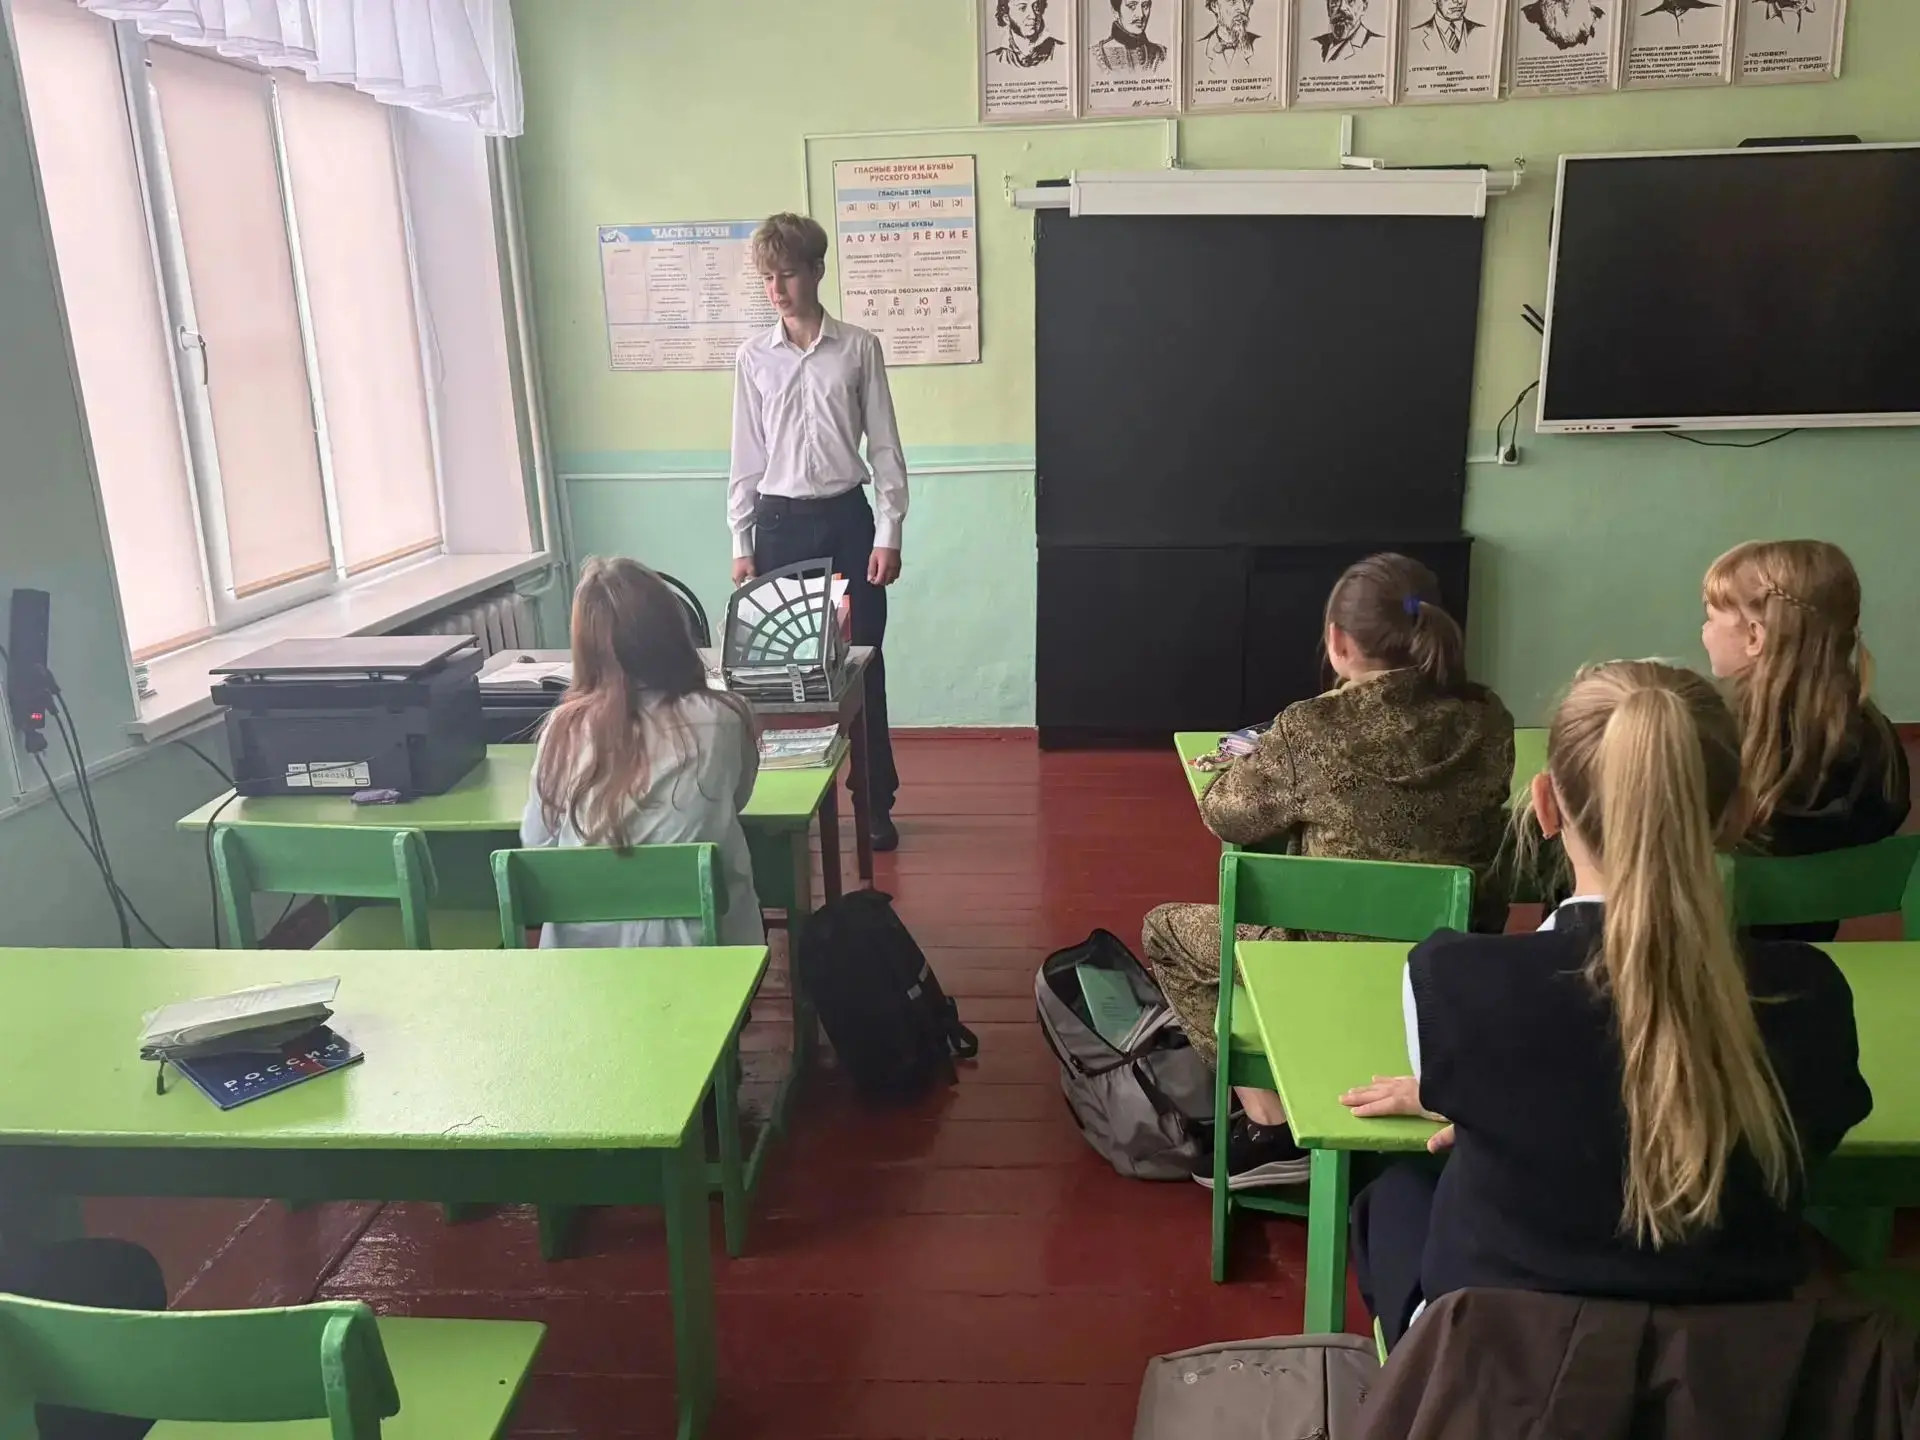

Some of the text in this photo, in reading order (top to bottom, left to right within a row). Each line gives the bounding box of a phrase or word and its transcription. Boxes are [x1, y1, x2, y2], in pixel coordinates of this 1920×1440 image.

[870, 174, 910, 182] РУССКОГО
[696, 226, 730, 238] РЕЧИ
[846, 234, 854, 243] А
[870, 234, 876, 242] У
[880, 233, 889, 242] Ы
[893, 232, 900, 241] Э
[913, 230, 968, 240] Я Ё Ю И Е
[868, 296, 952, 307] Я Ё Ю Е
[224, 1043, 339, 1089] РОССИЯ
